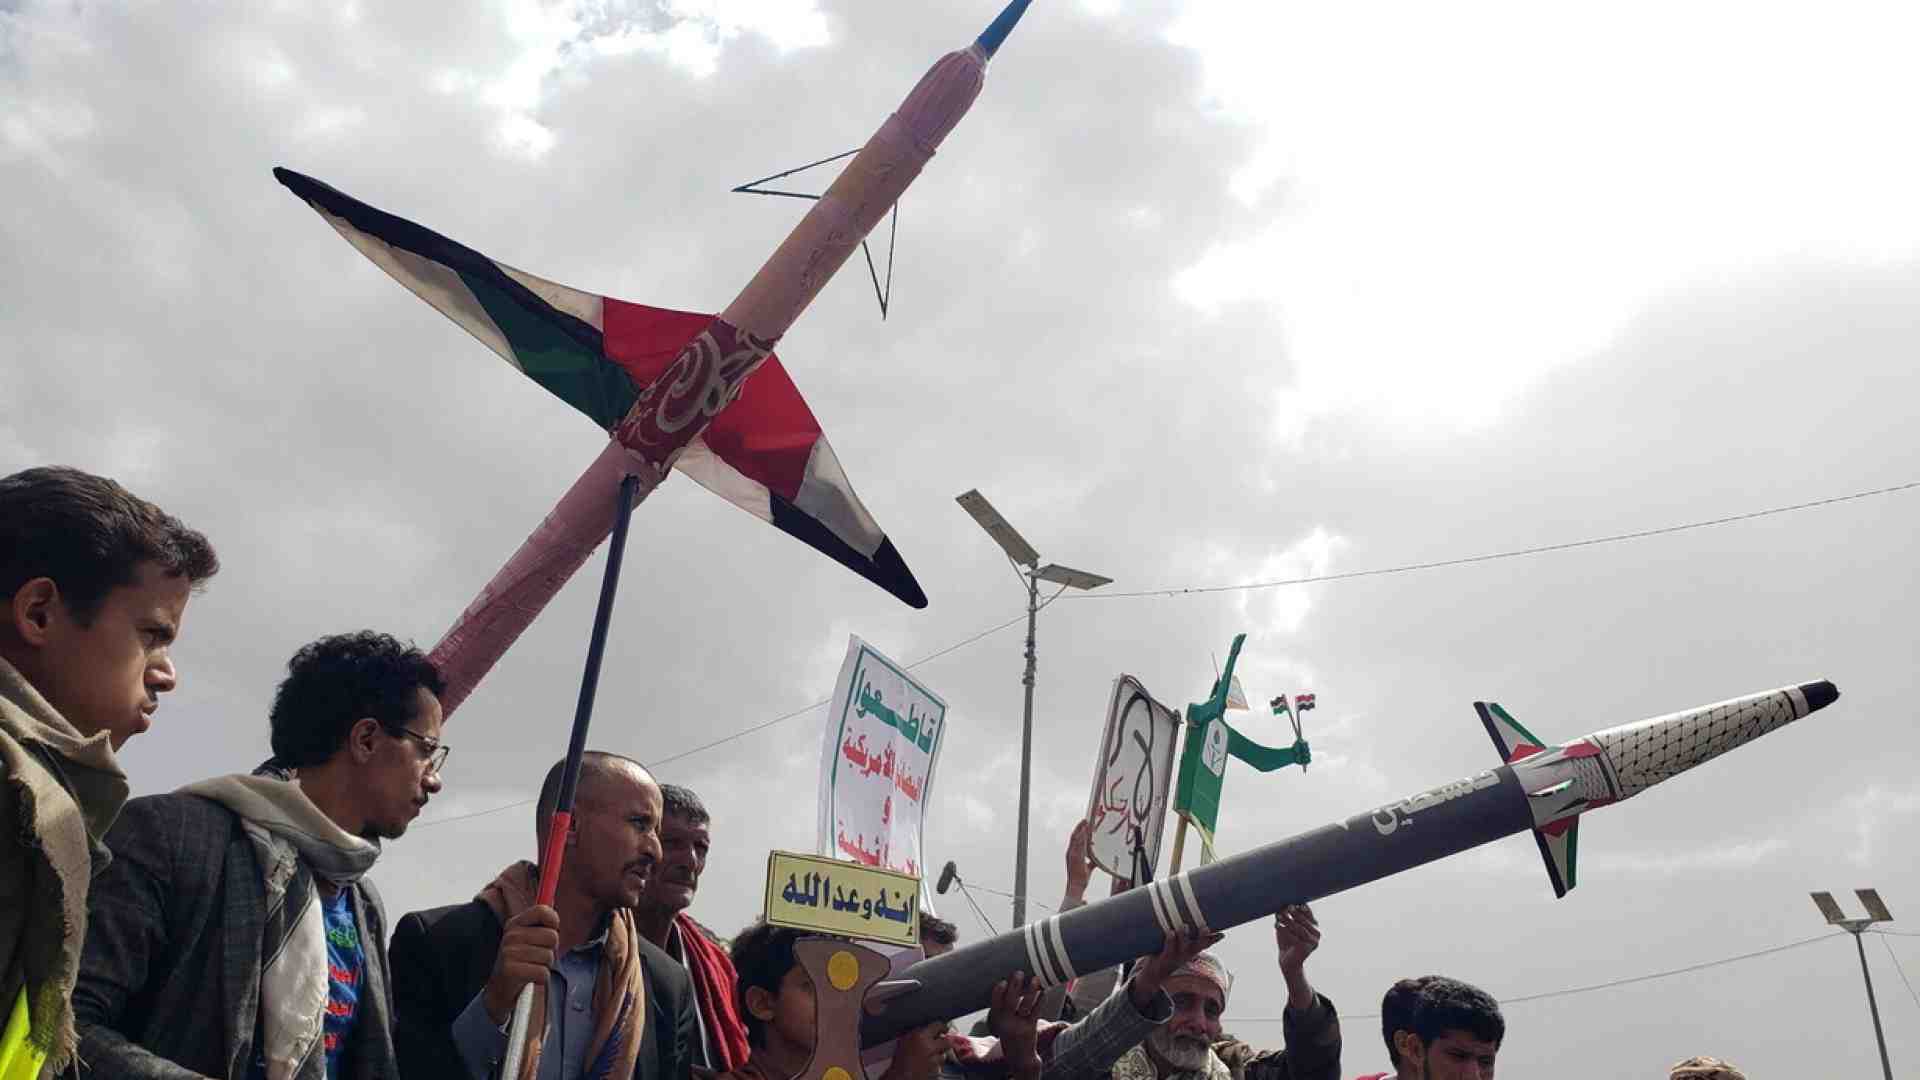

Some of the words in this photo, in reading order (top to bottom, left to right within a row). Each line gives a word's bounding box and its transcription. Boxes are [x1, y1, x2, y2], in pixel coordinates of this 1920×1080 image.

[855, 668, 934, 754] قاطعوا
[882, 795, 892, 824] و
[782, 871, 831, 908] الله
[832, 885, 873, 920] وعد
[874, 888, 915, 936] إنه
